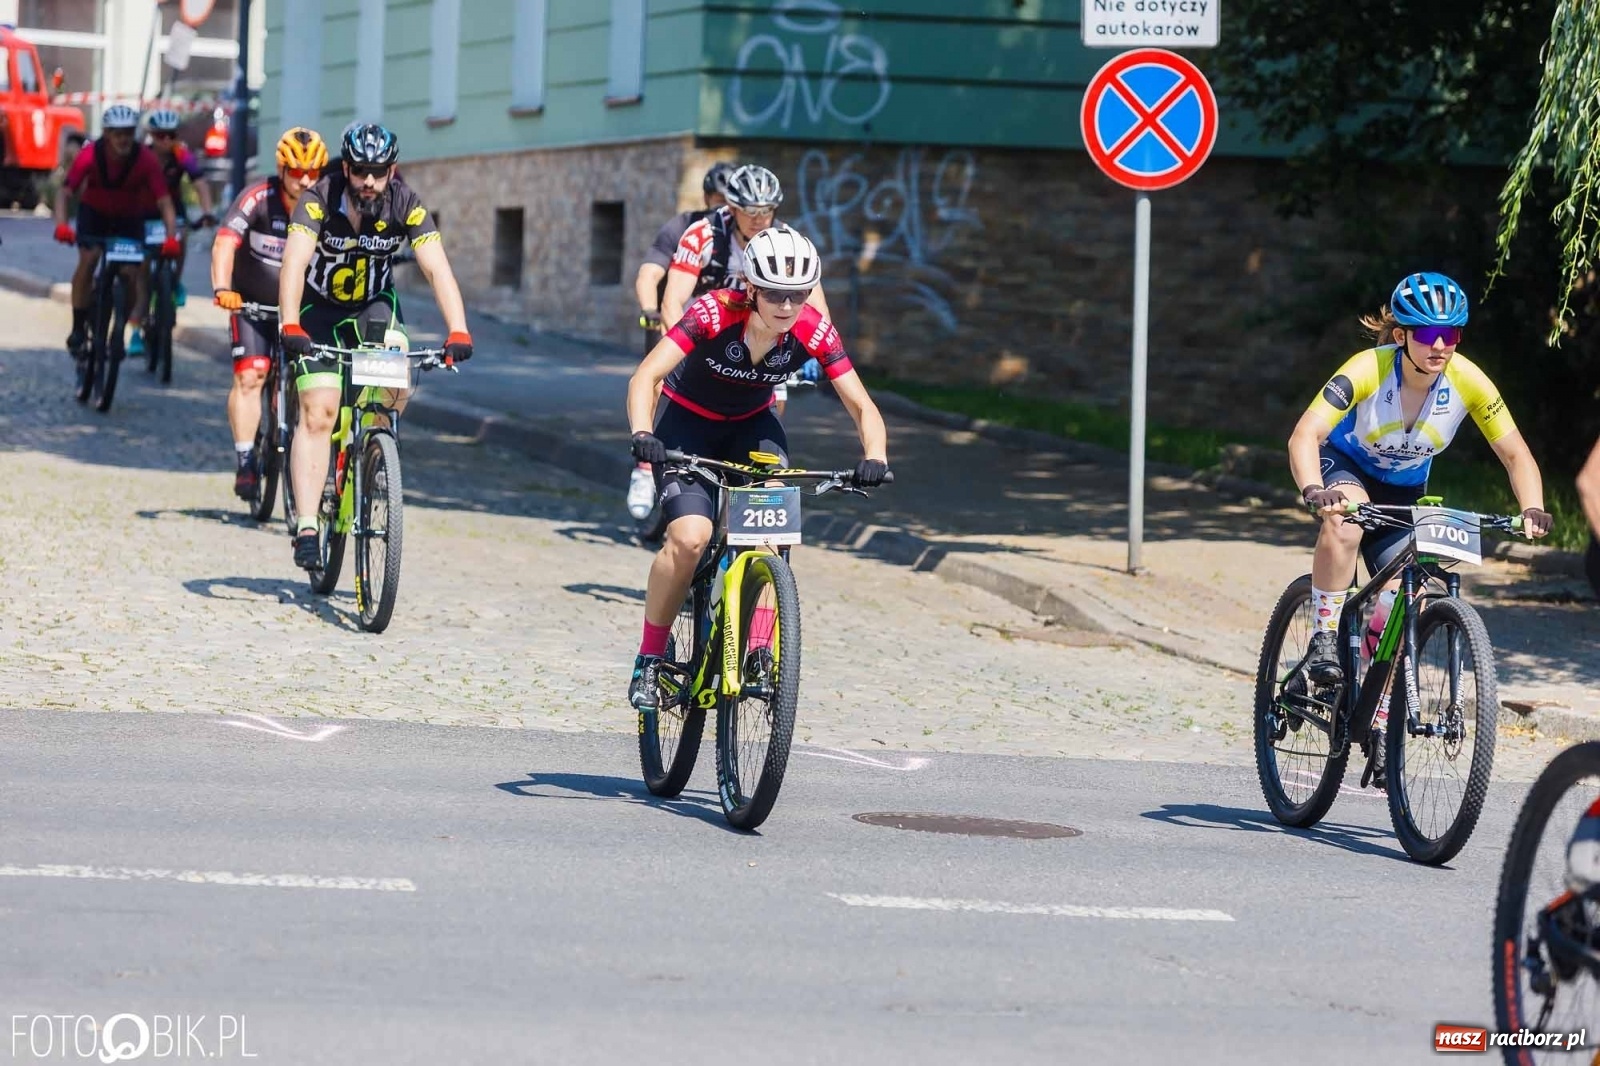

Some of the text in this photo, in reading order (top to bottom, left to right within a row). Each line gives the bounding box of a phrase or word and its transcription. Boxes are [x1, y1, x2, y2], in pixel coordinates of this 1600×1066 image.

[1094, 0, 1207, 17] Nie dotyczy
[1096, 20, 1199, 36] autokarów
[705, 357, 758, 381] RACING
[743, 508, 788, 527] 2183
[1427, 523, 1469, 545] 1700
